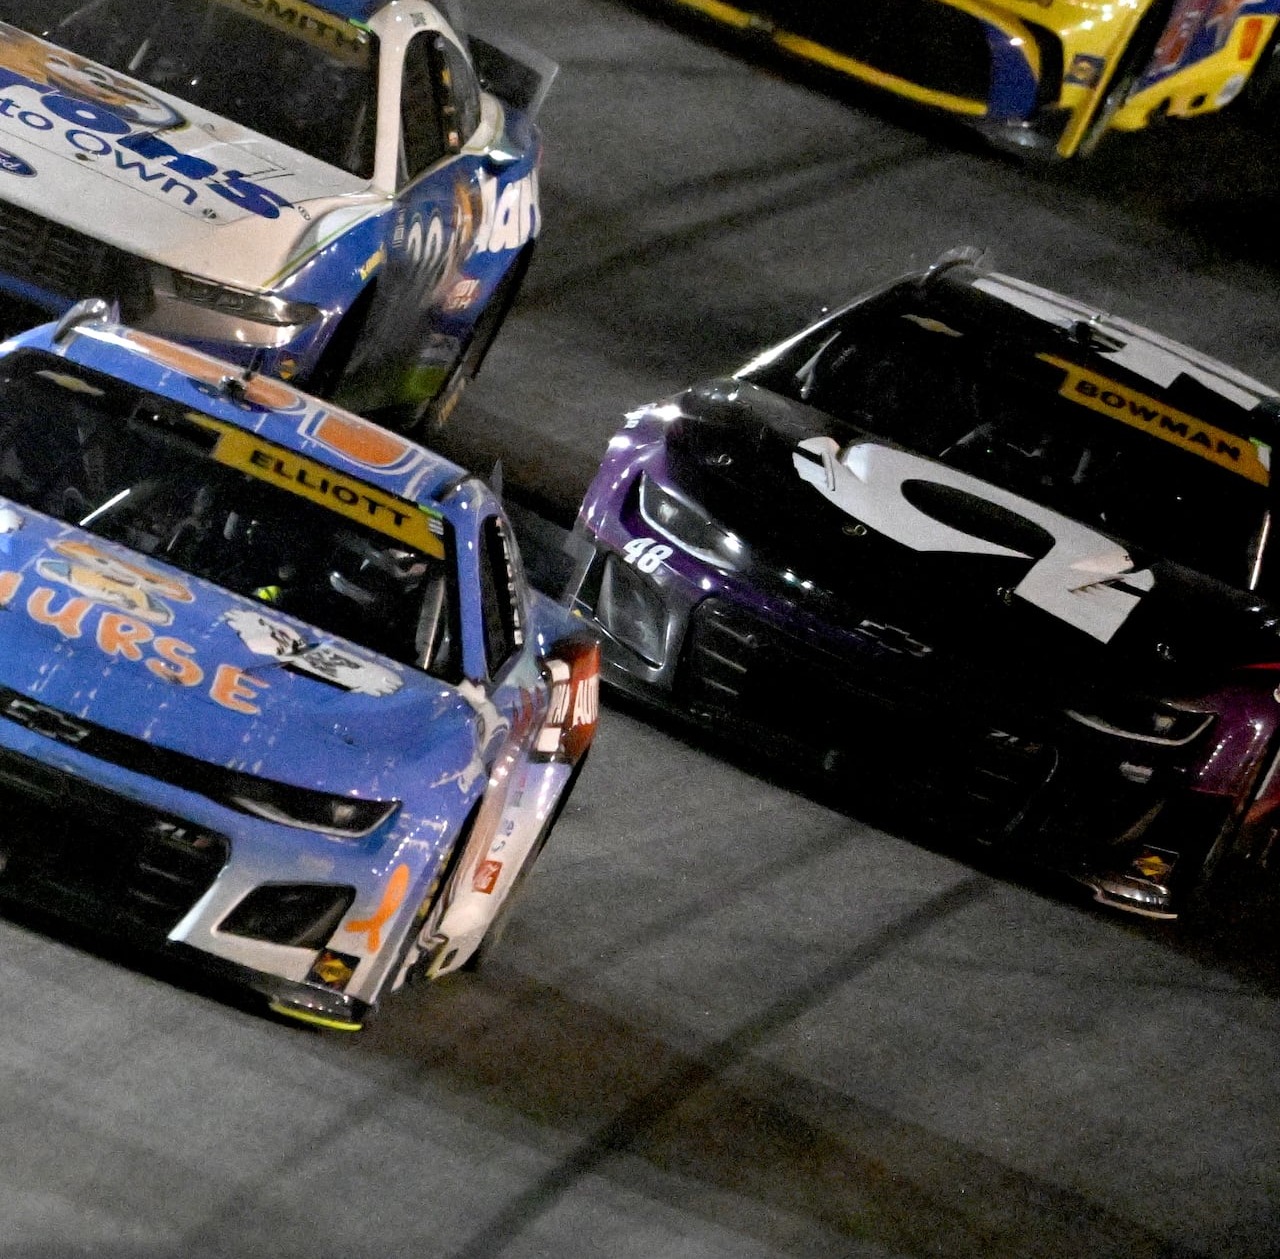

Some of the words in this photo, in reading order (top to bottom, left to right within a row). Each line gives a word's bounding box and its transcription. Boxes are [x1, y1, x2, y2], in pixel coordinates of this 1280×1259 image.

[65, 129, 198, 206] Own
[1074, 376, 1245, 466] BOWMAN
[249, 447, 413, 529] ELLIOTT
[623, 537, 674, 575] 48
